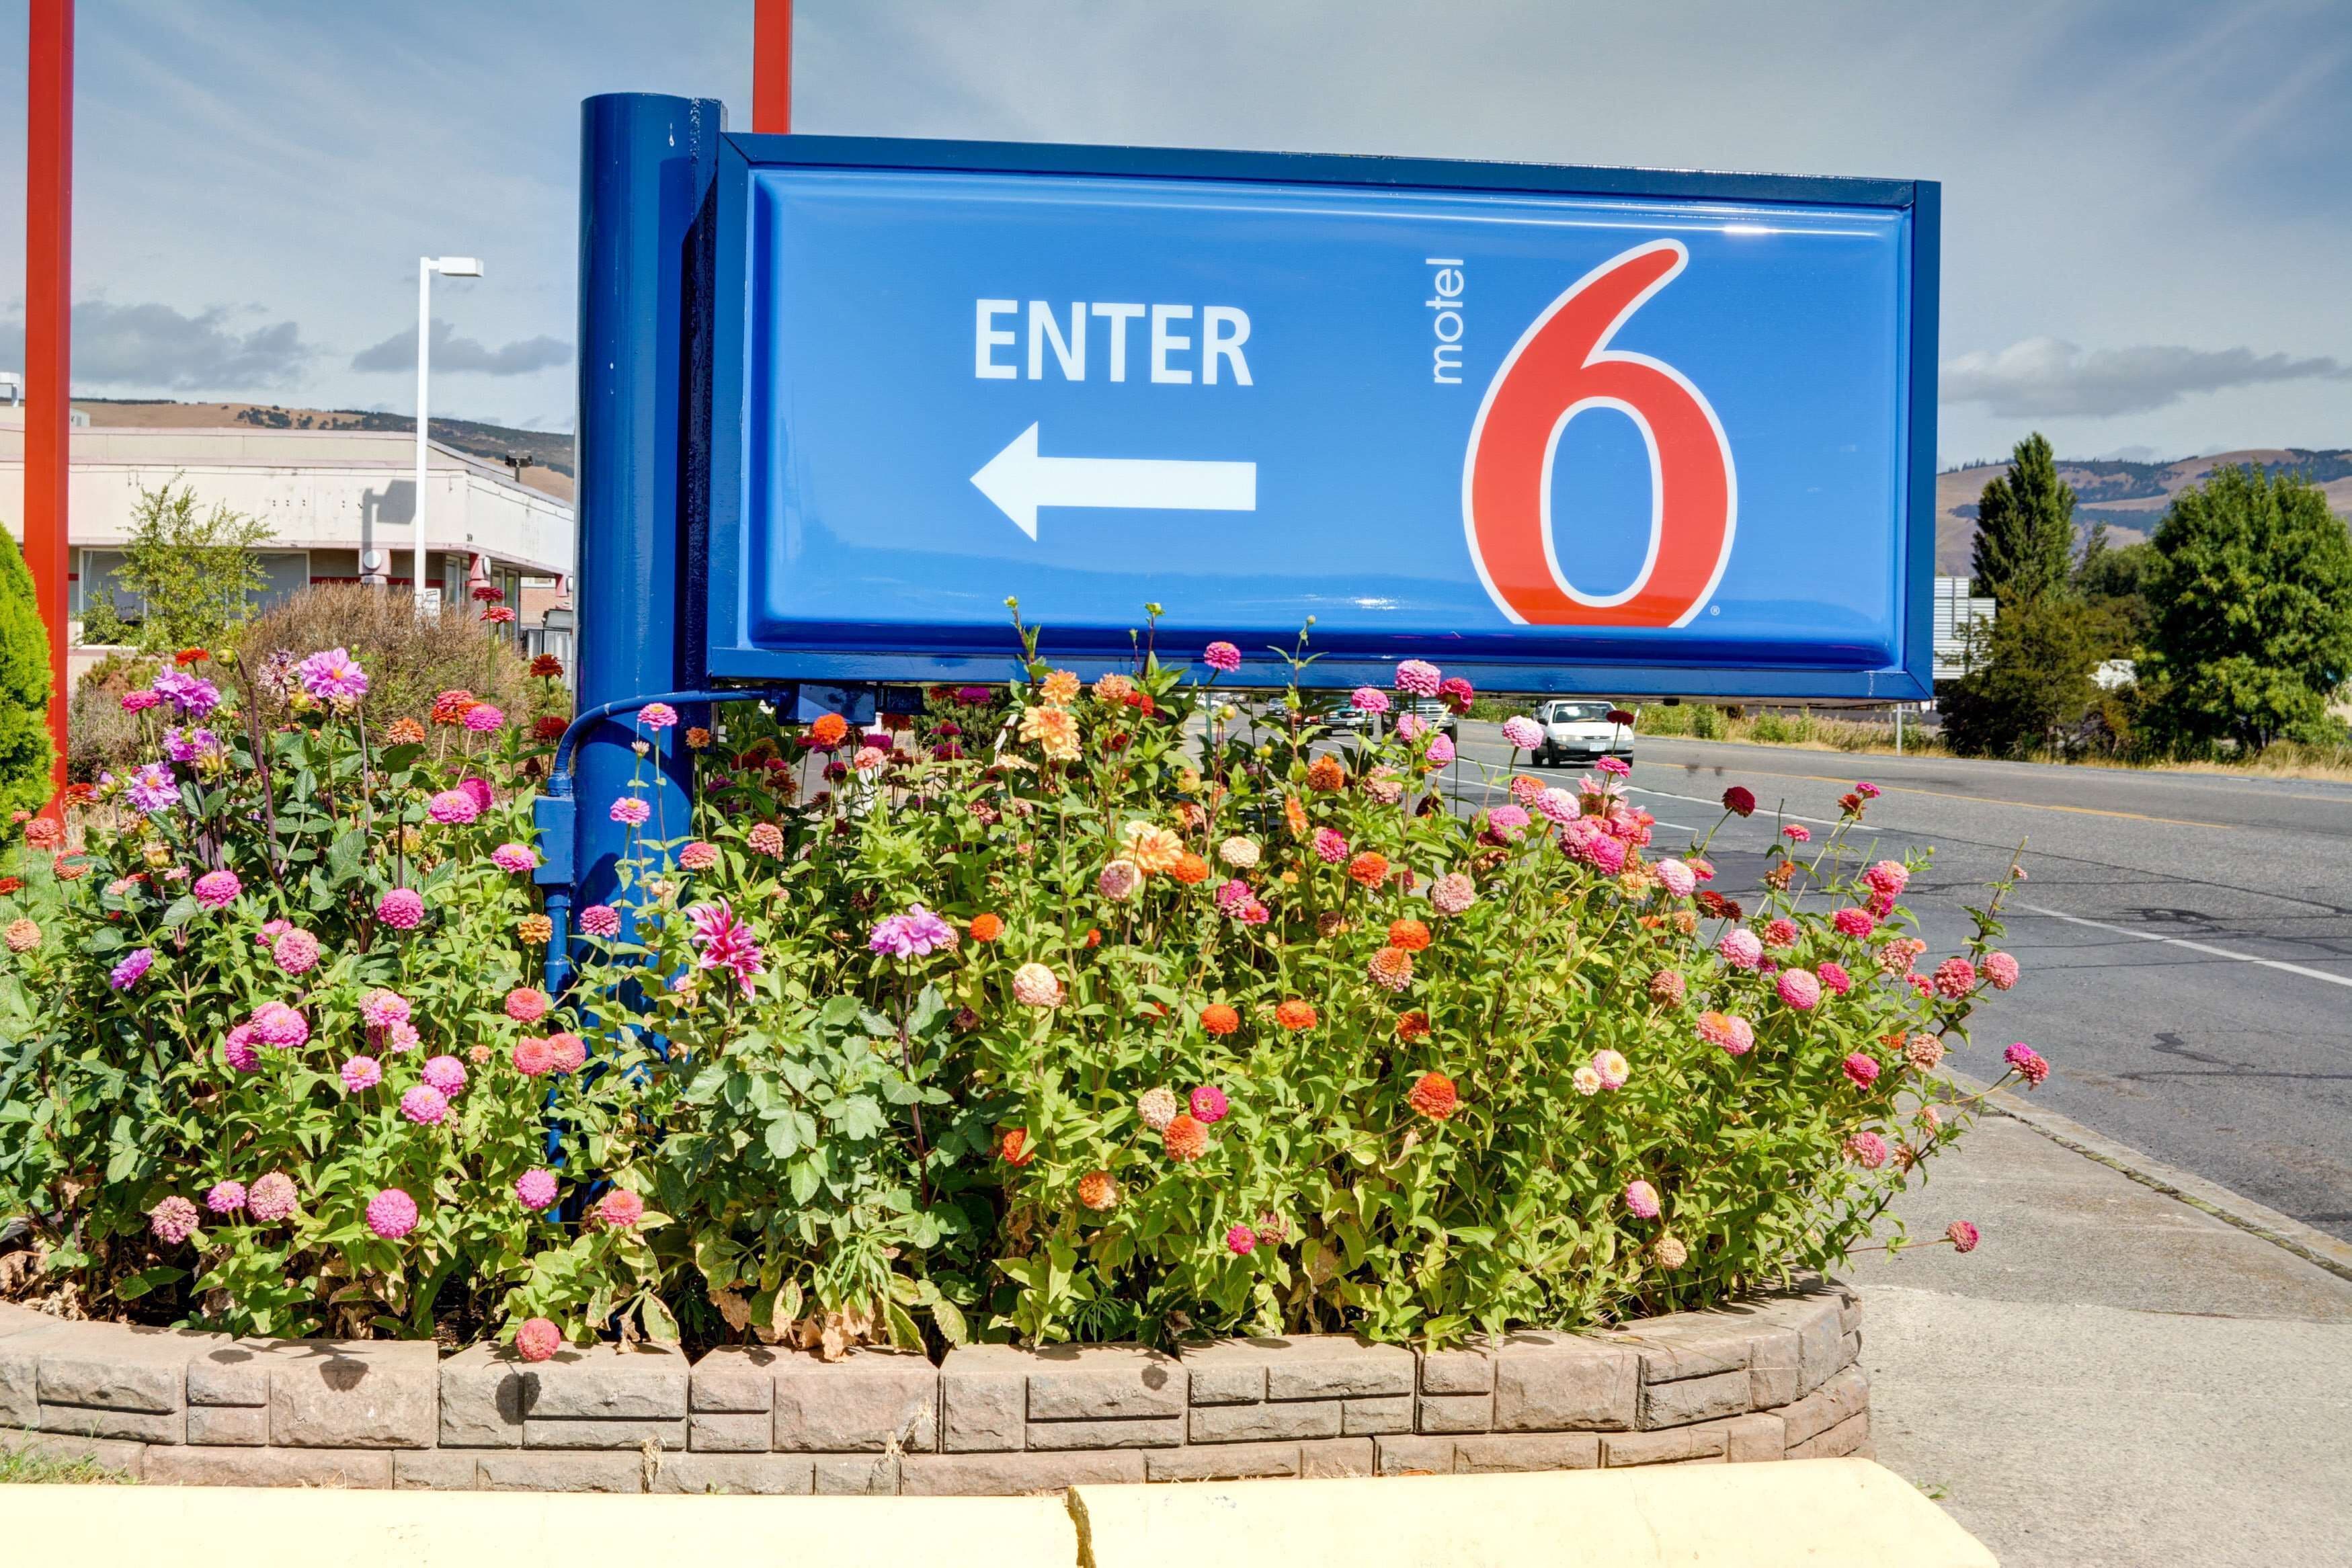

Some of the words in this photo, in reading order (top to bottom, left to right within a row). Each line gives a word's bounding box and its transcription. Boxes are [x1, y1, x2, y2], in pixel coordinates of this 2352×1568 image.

[975, 299, 1254, 386] ENTER
[1425, 257, 1465, 384] motel
[1461, 238, 1738, 628] 6
